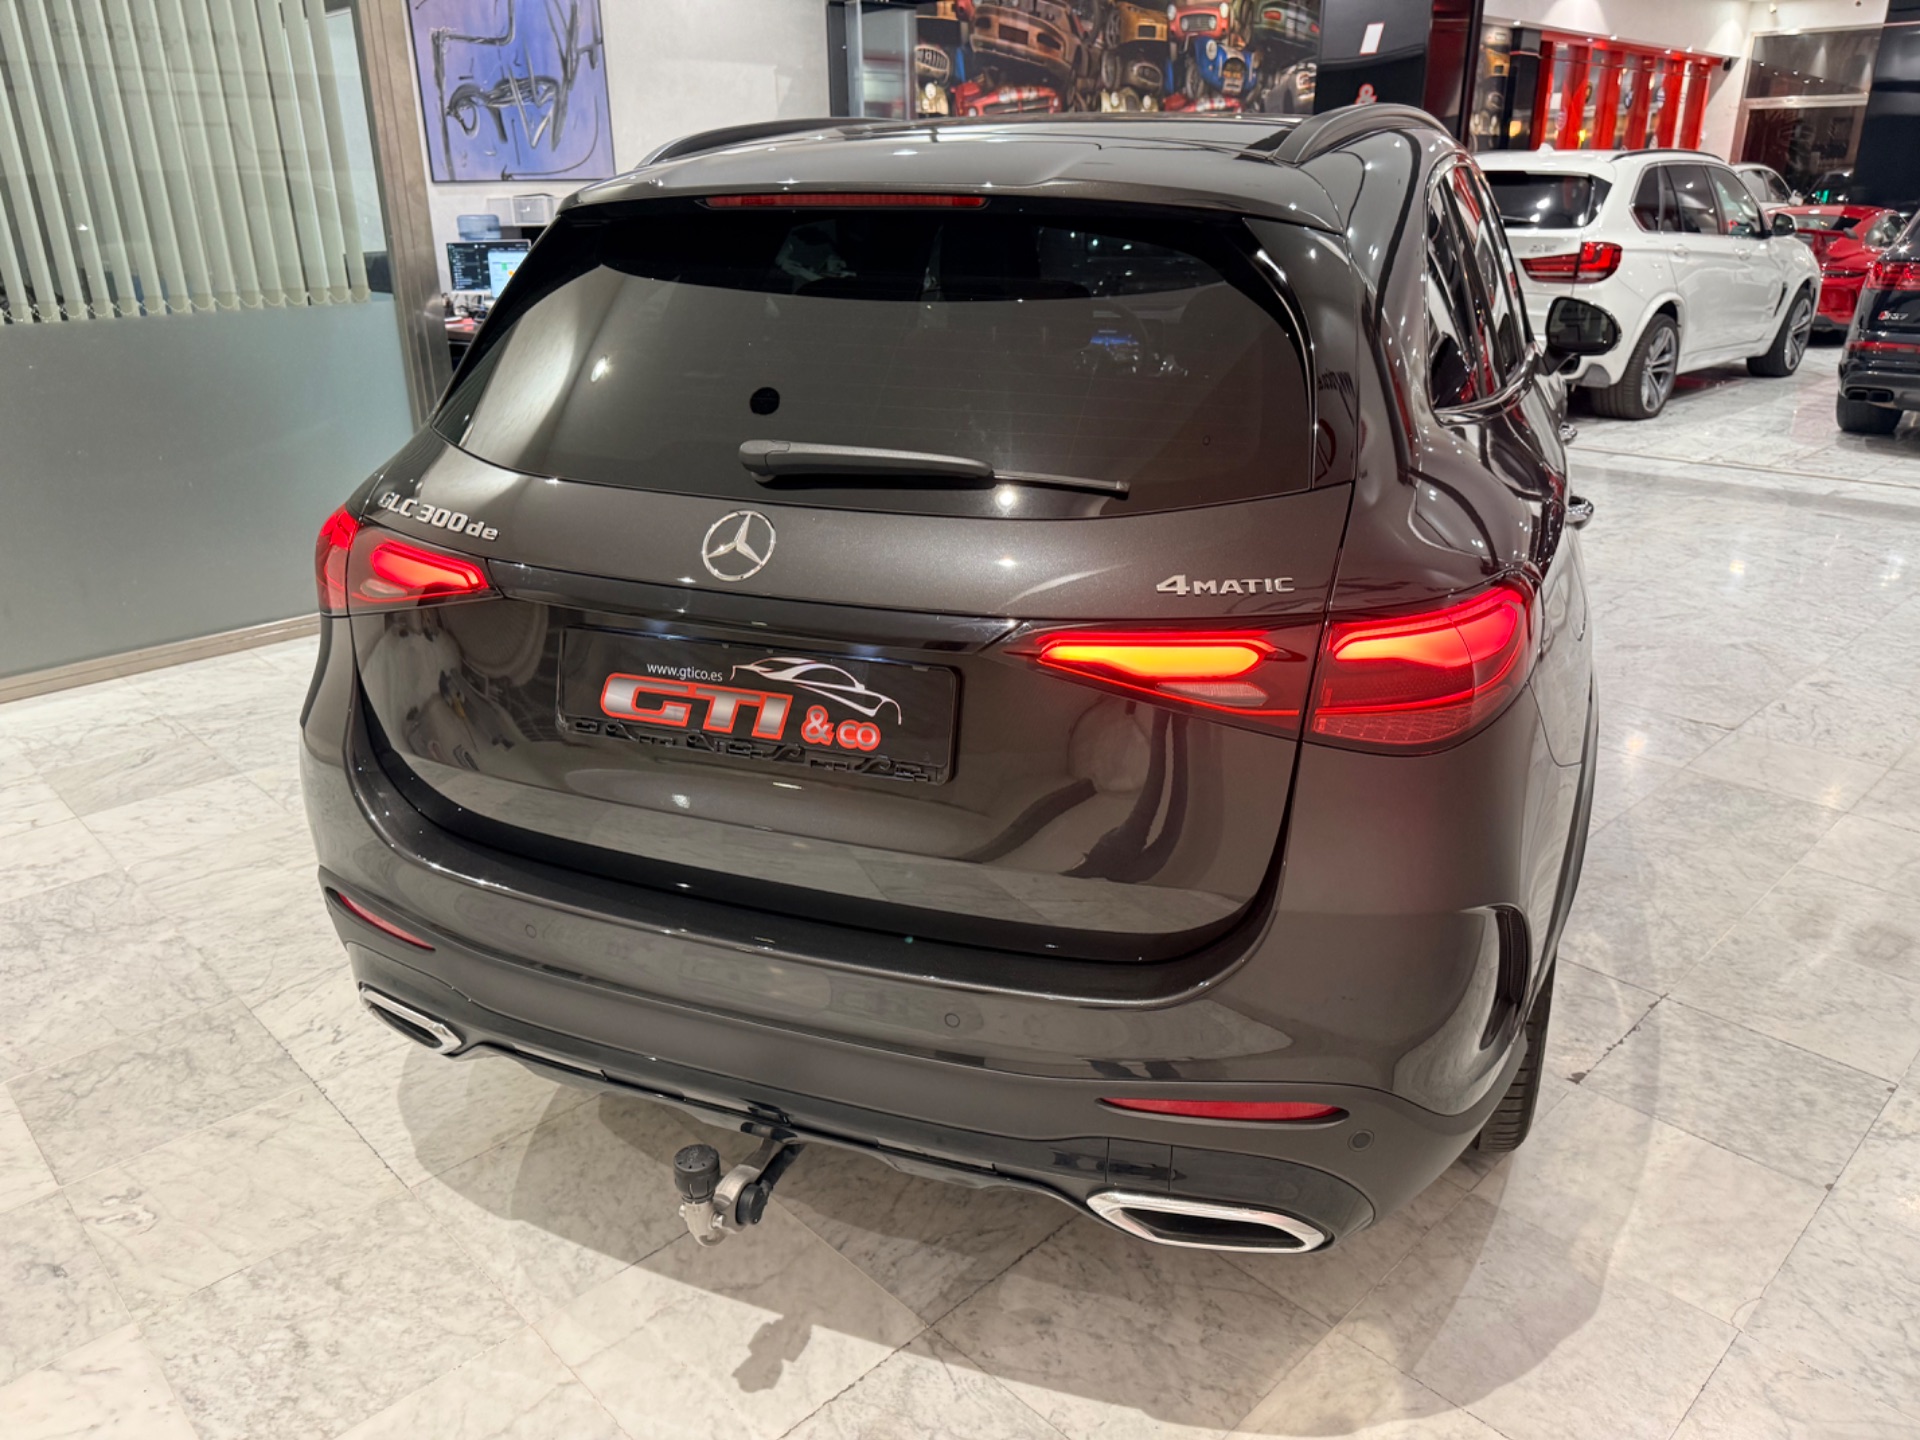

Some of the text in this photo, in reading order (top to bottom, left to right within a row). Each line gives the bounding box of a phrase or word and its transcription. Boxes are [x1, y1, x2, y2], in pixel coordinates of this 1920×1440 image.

[378, 491, 418, 518] GLC
[1156, 574, 1295, 597] 4MATIC
[646, 662, 723, 683] www.gtico.es
[600, 672, 794, 741] GTI
